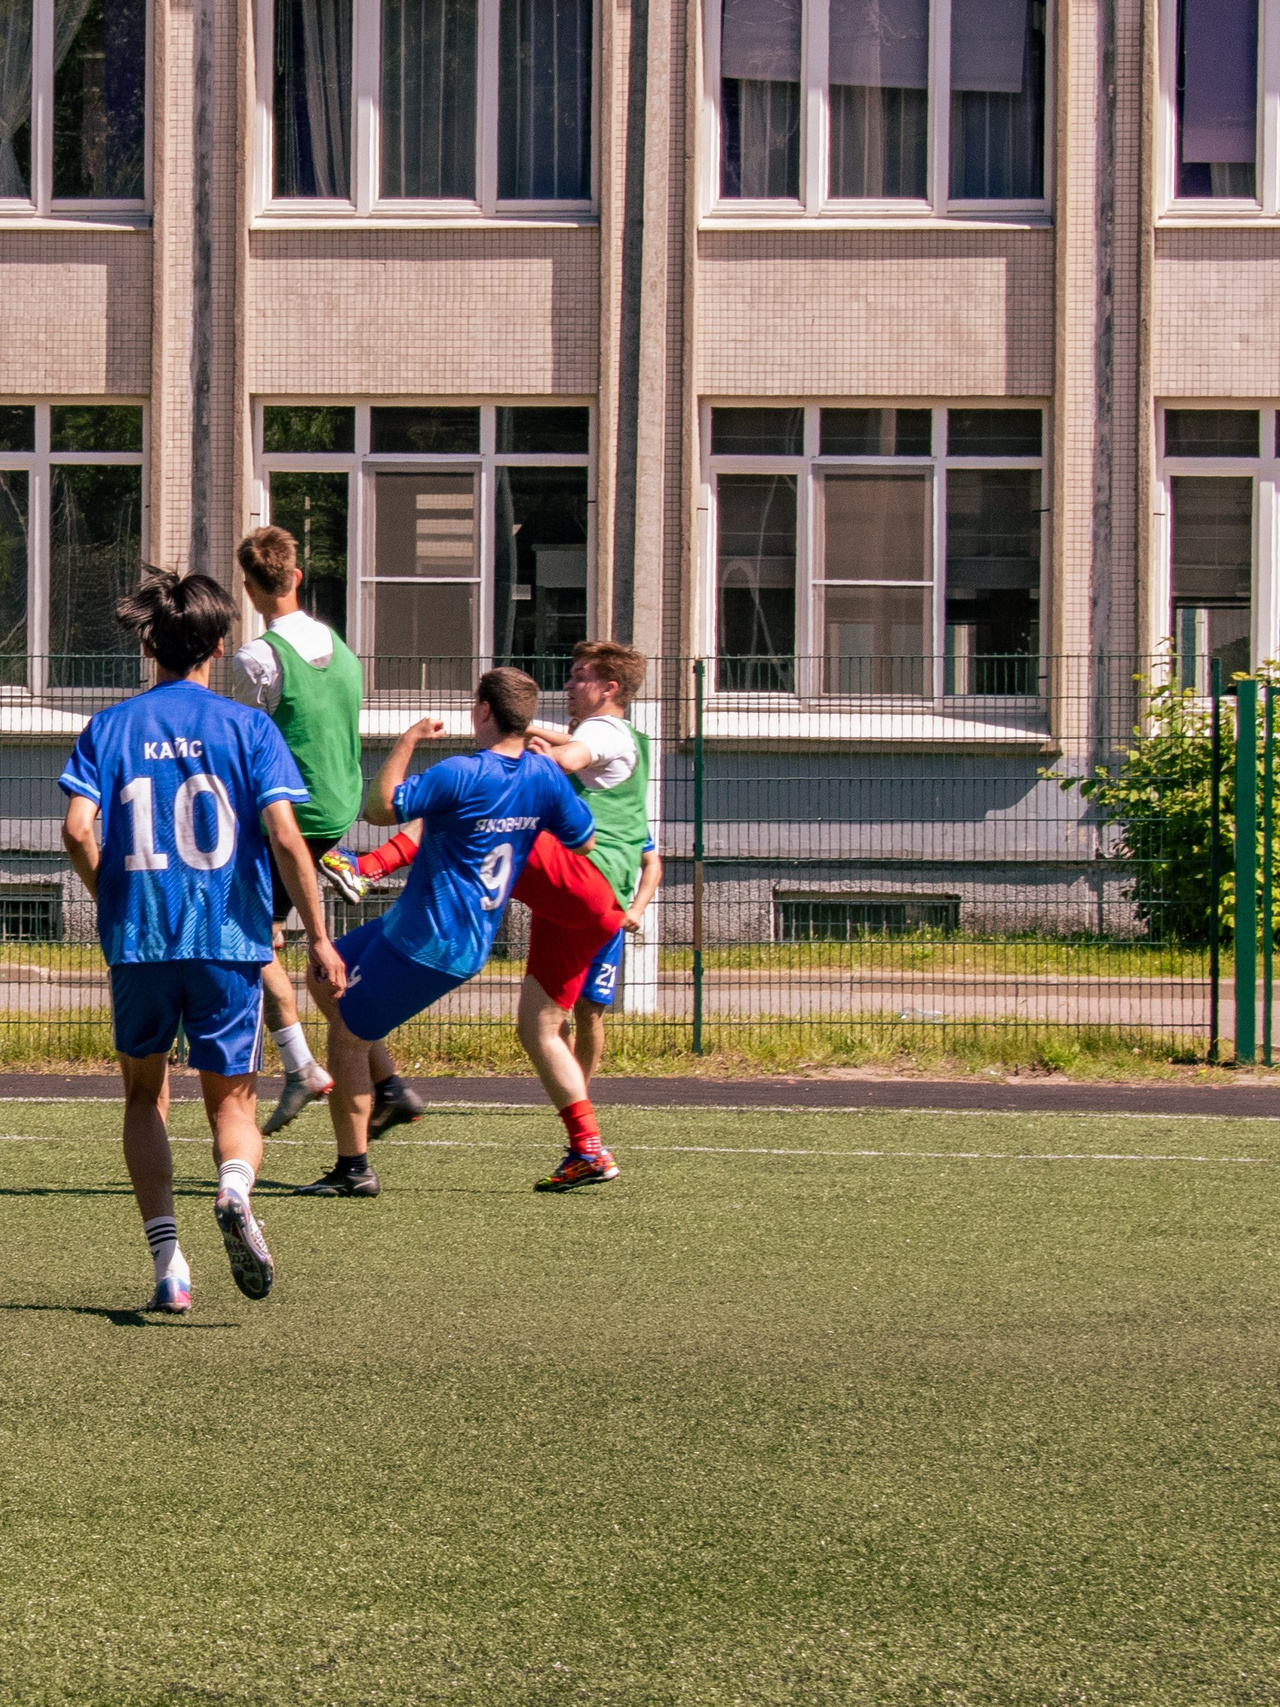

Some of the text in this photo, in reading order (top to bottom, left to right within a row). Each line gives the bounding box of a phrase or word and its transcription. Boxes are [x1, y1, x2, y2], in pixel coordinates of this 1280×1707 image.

[144, 737, 203, 760] КАЙС
[120, 774, 236, 871] 10
[479, 843, 513, 911] 9
[595, 963, 617, 988] 21
